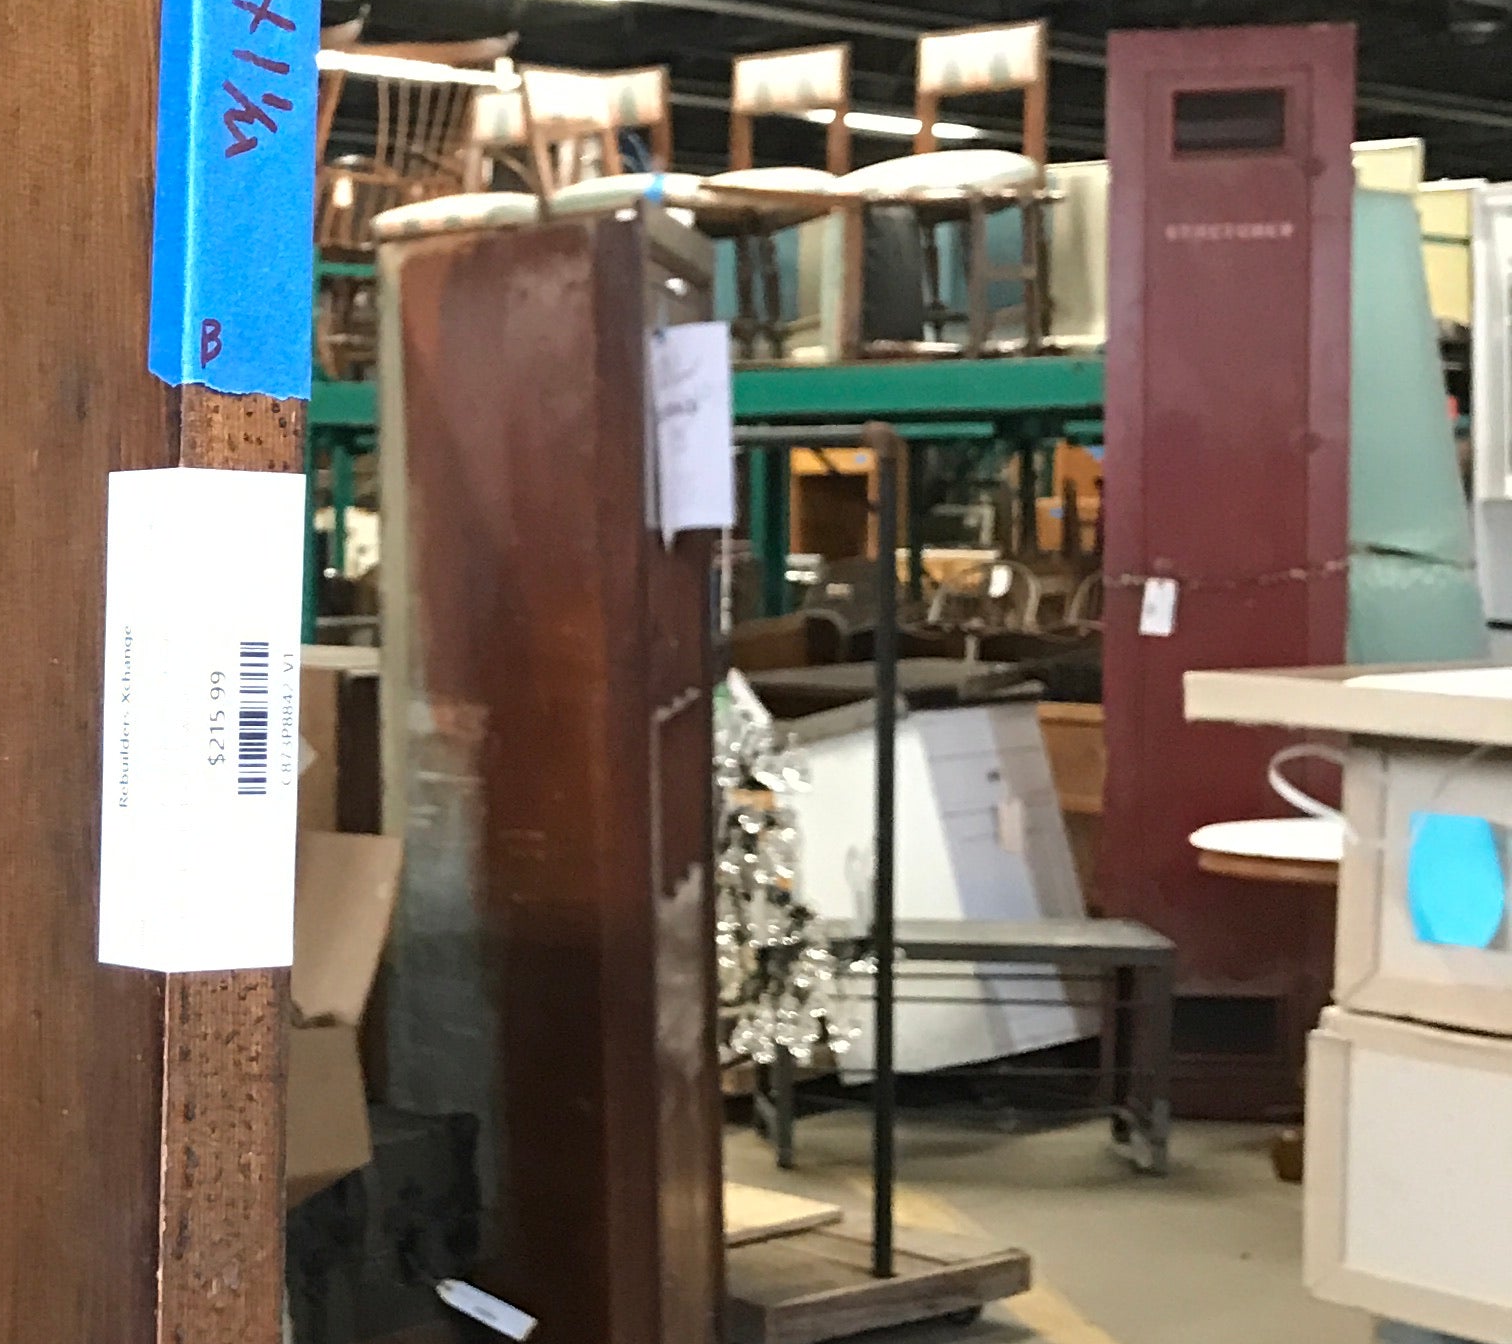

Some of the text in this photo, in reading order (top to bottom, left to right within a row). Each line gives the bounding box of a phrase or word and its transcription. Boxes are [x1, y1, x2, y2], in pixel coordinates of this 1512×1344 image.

[199, 318, 223, 370] B
[118, 624, 133, 808] Rebuilders Xchange
[206, 670, 226, 767] $21599
